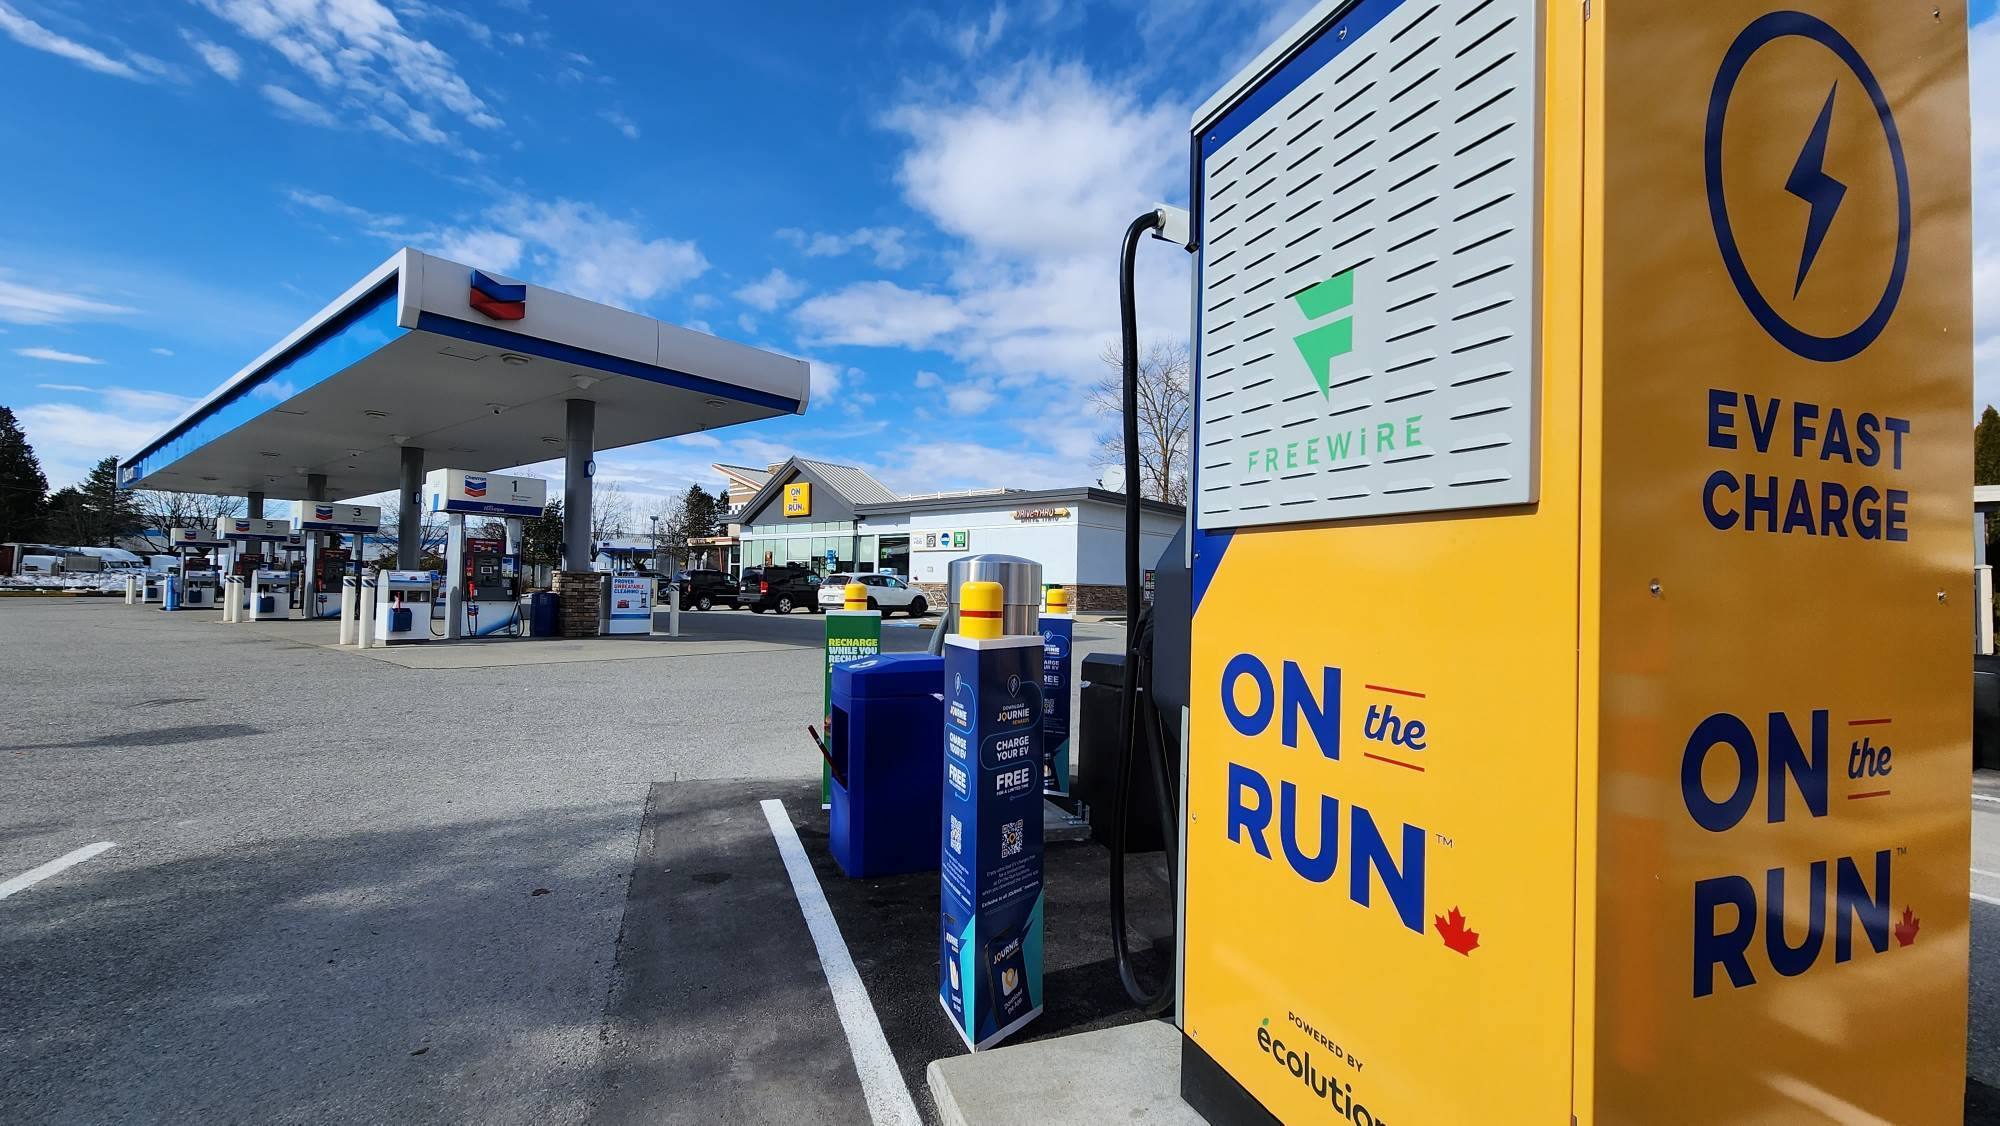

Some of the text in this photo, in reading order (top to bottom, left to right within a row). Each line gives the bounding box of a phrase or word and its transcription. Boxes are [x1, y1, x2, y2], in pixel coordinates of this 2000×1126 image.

[1707, 388, 1911, 471] EV FAST
[512, 480, 518, 492] 1
[790, 488, 801, 496] ON
[353, 507, 361, 517] 3
[788, 503, 803, 511] RUN
[1702, 469, 1909, 542] CHARGE
[266, 521, 274, 529] 5
[828, 638, 878, 647] RECHARGE
[828, 646, 878, 655] WHILE YOU
[1043, 674, 1060, 683] REE
[996, 708, 1030, 722] JOURNIE
[1220, 653, 1427, 761] ON the
[996, 735, 1030, 751] CHARGE
[996, 748, 1018, 762] YOUR
[1019, 746, 1030, 757] EV
[949, 763, 967, 790] FREE
[996, 767, 1030, 791] FREE
[1680, 709, 1893, 833] ON the
[1227, 761, 1427, 936] RUN
[1692, 848, 1892, 999] RUN
[993, 937, 1019, 965] JOURNIE
[1288, 1010, 1364, 1073] POWERED BY
